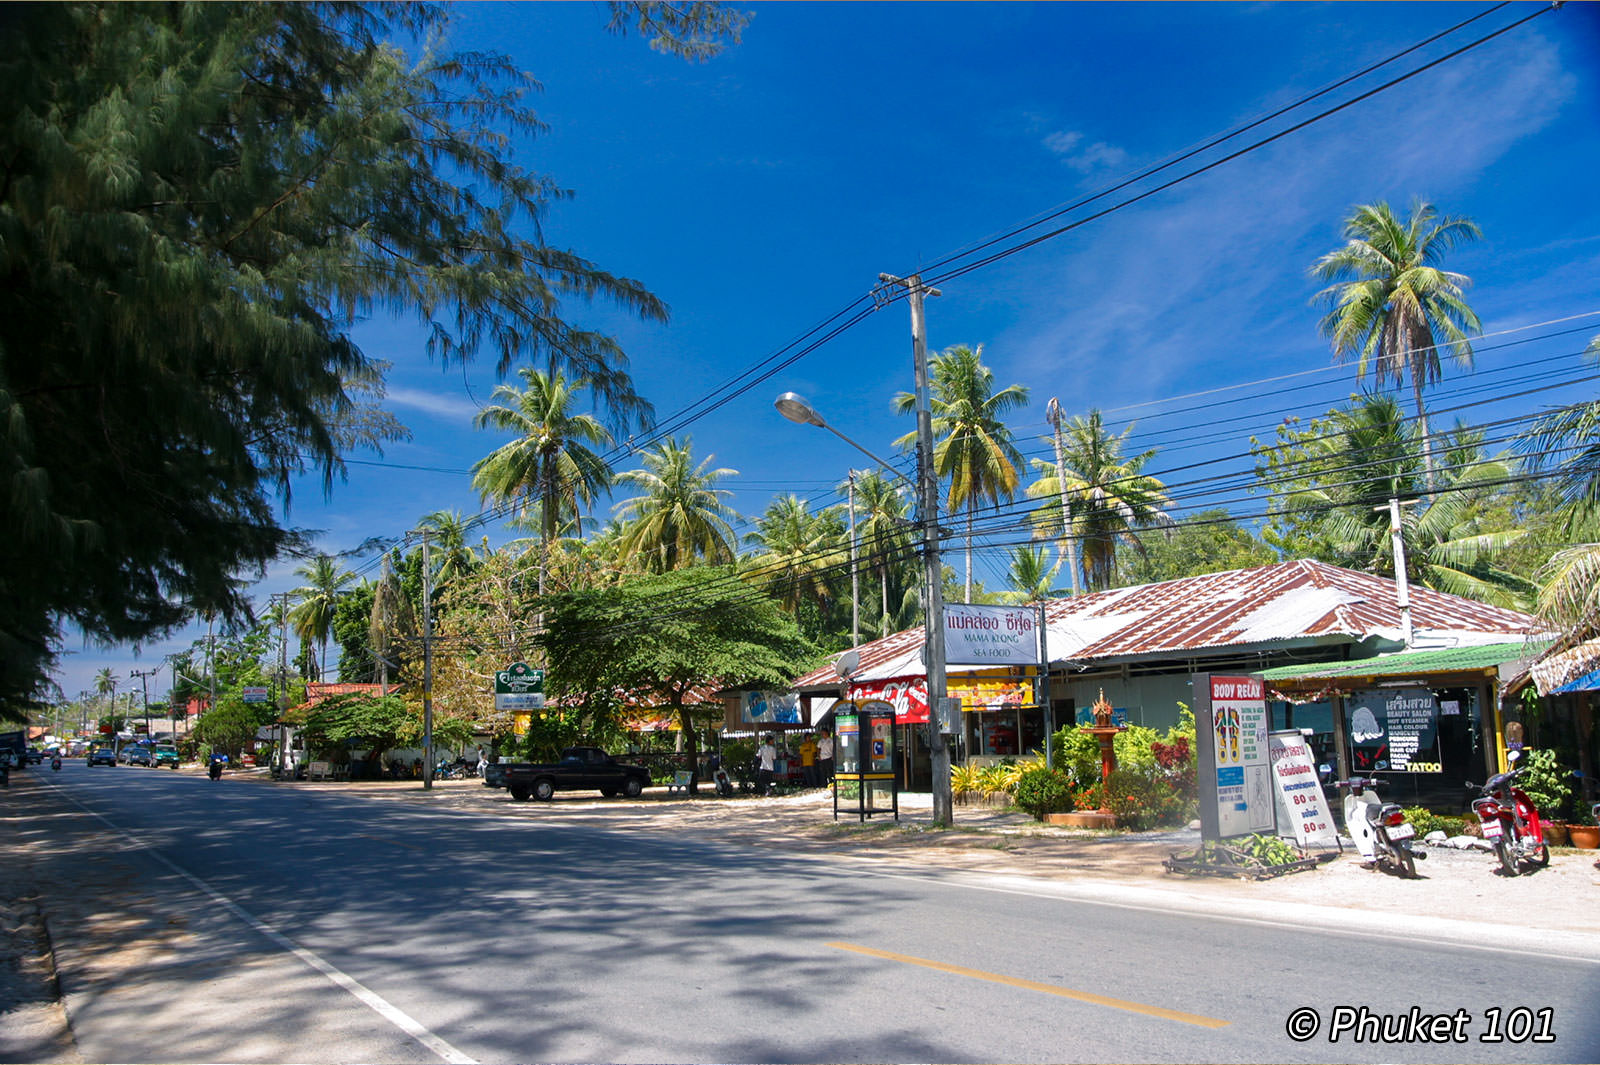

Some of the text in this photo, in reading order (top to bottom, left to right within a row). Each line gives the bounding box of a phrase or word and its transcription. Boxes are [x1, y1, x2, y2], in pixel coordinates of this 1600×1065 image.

[964, 634, 1019, 644] MAMA KLONG
[973, 648, 1011, 657] SEA FOOD
[1213, 683, 1261, 698] BODY RELAX
[1406, 762, 1442, 772] TATOO
[1293, 794, 1306, 805] 80
[1303, 822, 1316, 833] 80
